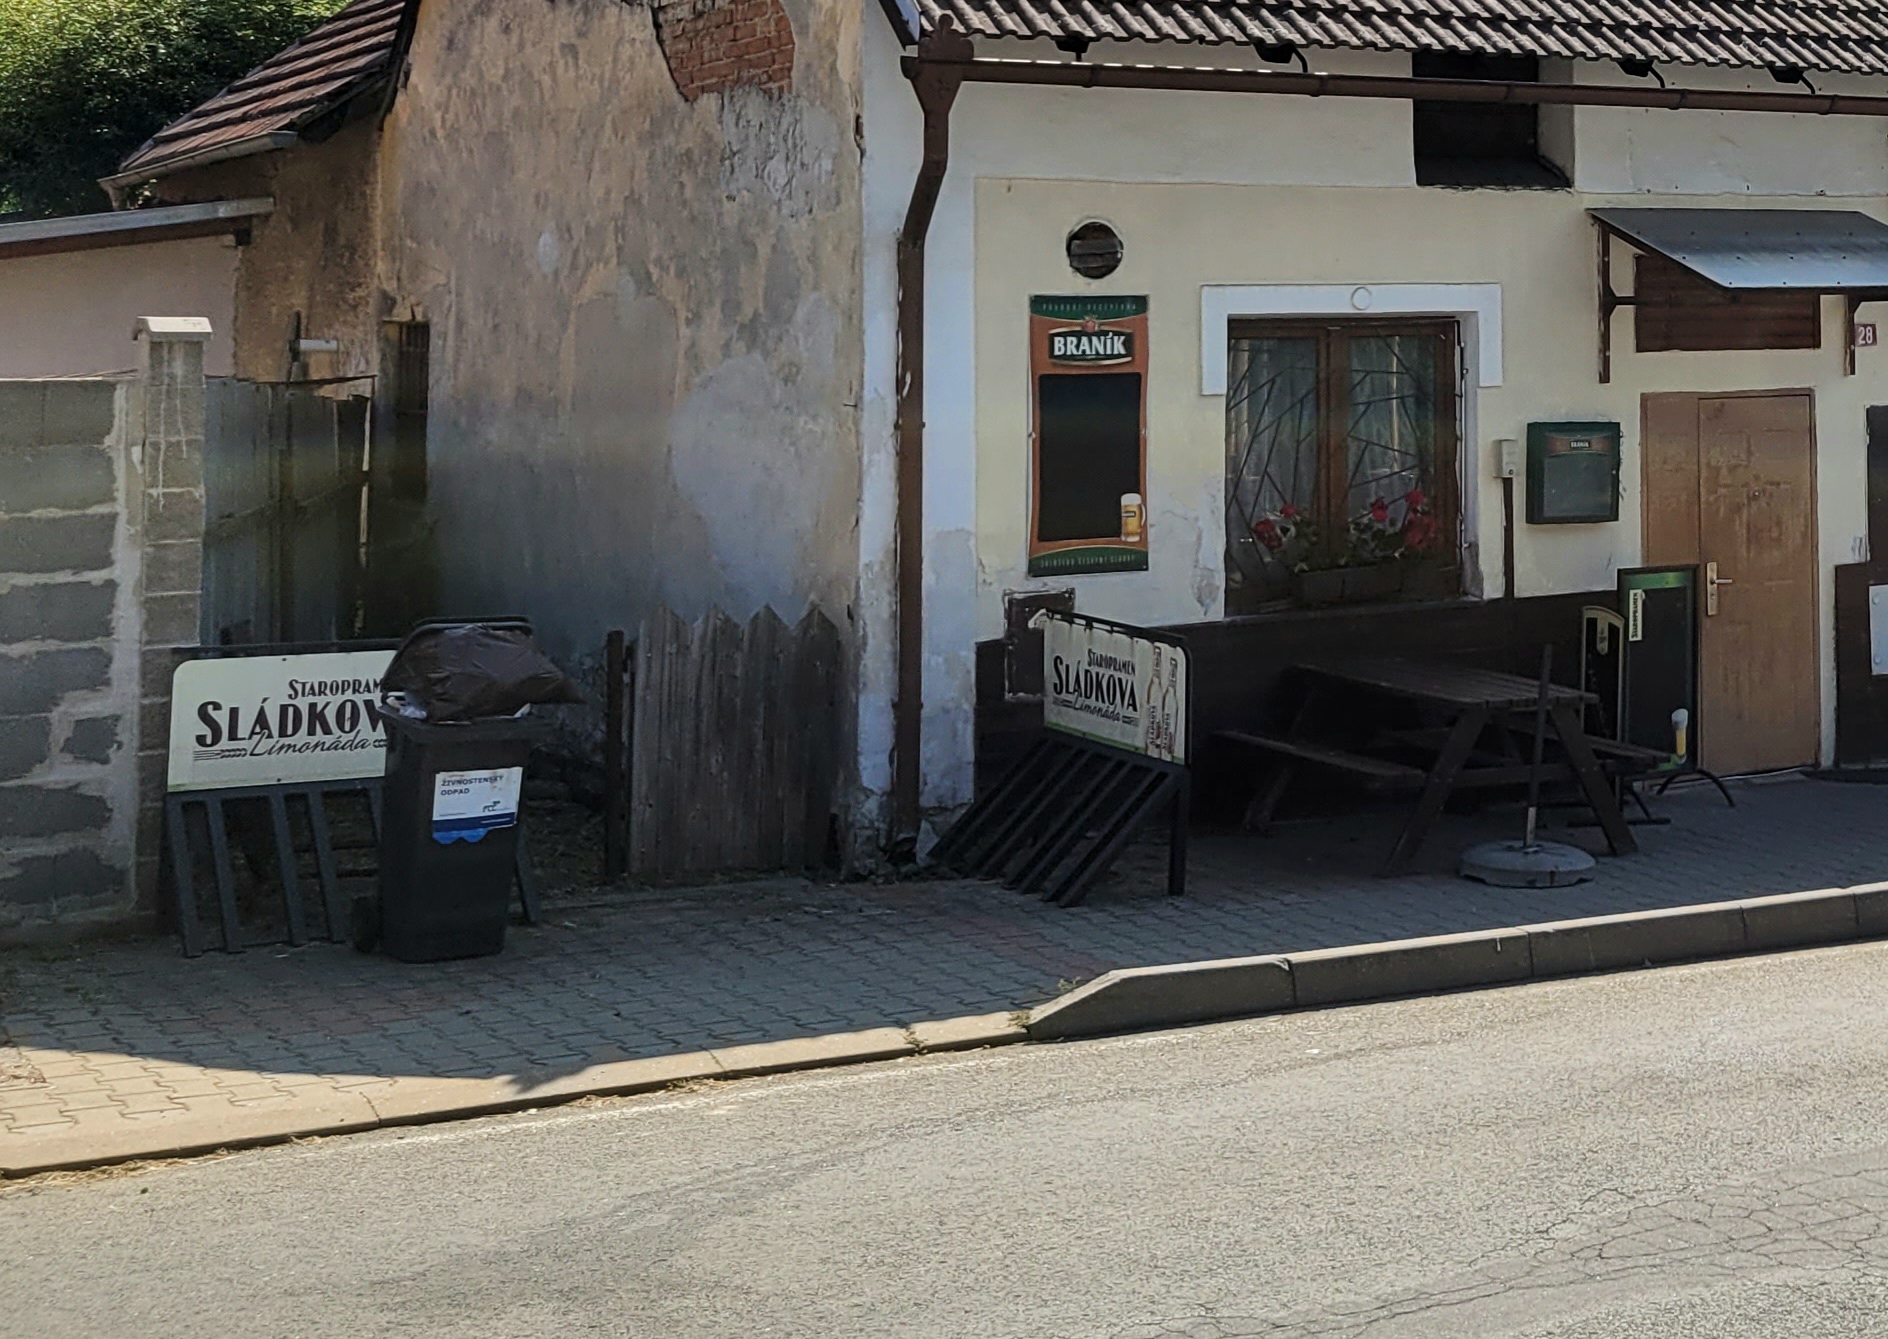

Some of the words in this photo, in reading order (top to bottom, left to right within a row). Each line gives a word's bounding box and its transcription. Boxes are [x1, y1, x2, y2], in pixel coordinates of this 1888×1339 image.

[1053, 332, 1127, 356] BRANÍK
[1859, 326, 1873, 344] 28
[1087, 648, 1136, 676] STAROPRAMEN
[288, 678, 383, 700] STAROPRAM
[1053, 655, 1138, 713] SLÁDKOVA
[195, 697, 387, 748] SLÁDKOV
[249, 729, 372, 757] Limonáda
[440, 788, 470, 796] ODPAD
